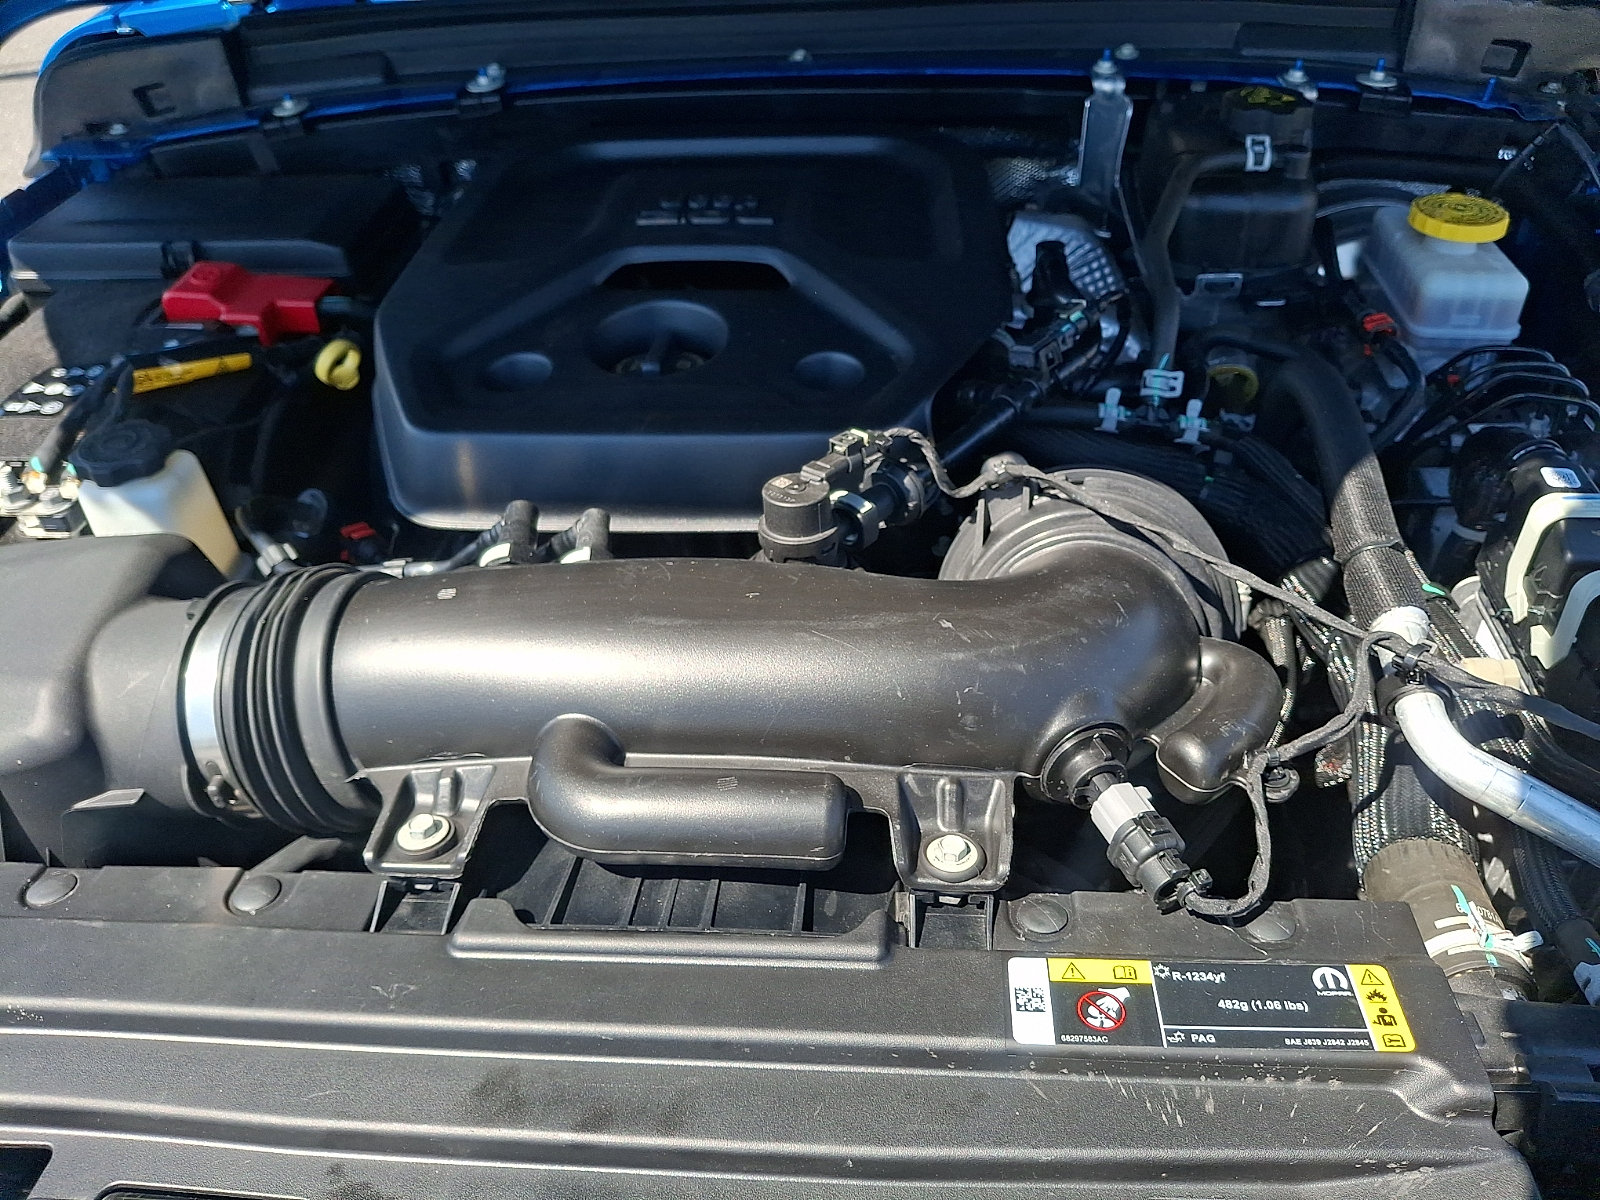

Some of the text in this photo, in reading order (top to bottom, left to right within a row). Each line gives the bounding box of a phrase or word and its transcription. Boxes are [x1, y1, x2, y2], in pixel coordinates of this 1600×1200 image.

[1171, 971, 1227, 983] R-1234yf
[1284, 1001, 1309, 1013] lbs)
[1190, 1033, 1216, 1043] PAG
